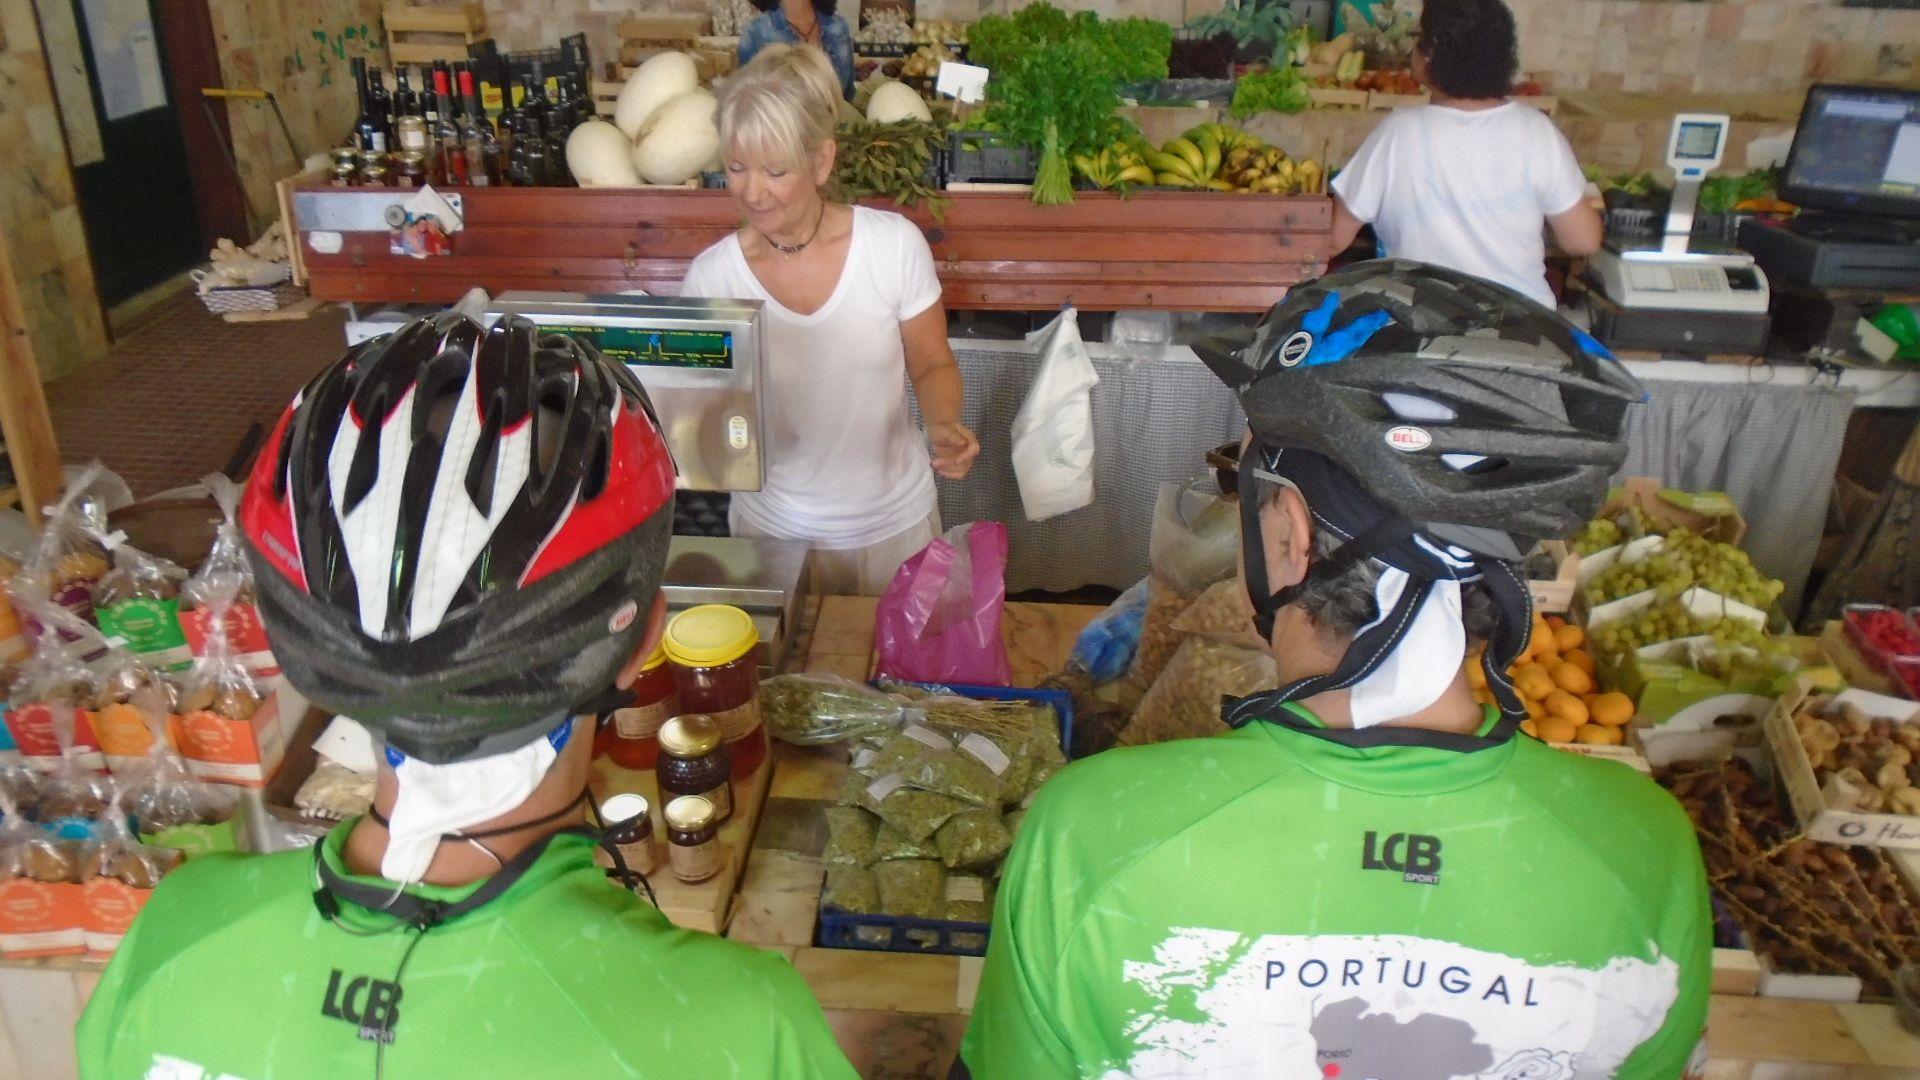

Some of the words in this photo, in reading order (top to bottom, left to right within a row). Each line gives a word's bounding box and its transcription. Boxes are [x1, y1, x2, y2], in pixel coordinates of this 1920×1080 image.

[1392, 432, 1424, 445] BELL
[1361, 831, 1442, 873] LCB
[1404, 872, 1440, 885] SPORT
[322, 968, 403, 1029] LCB
[1265, 957, 1538, 1006] PORTUGAL
